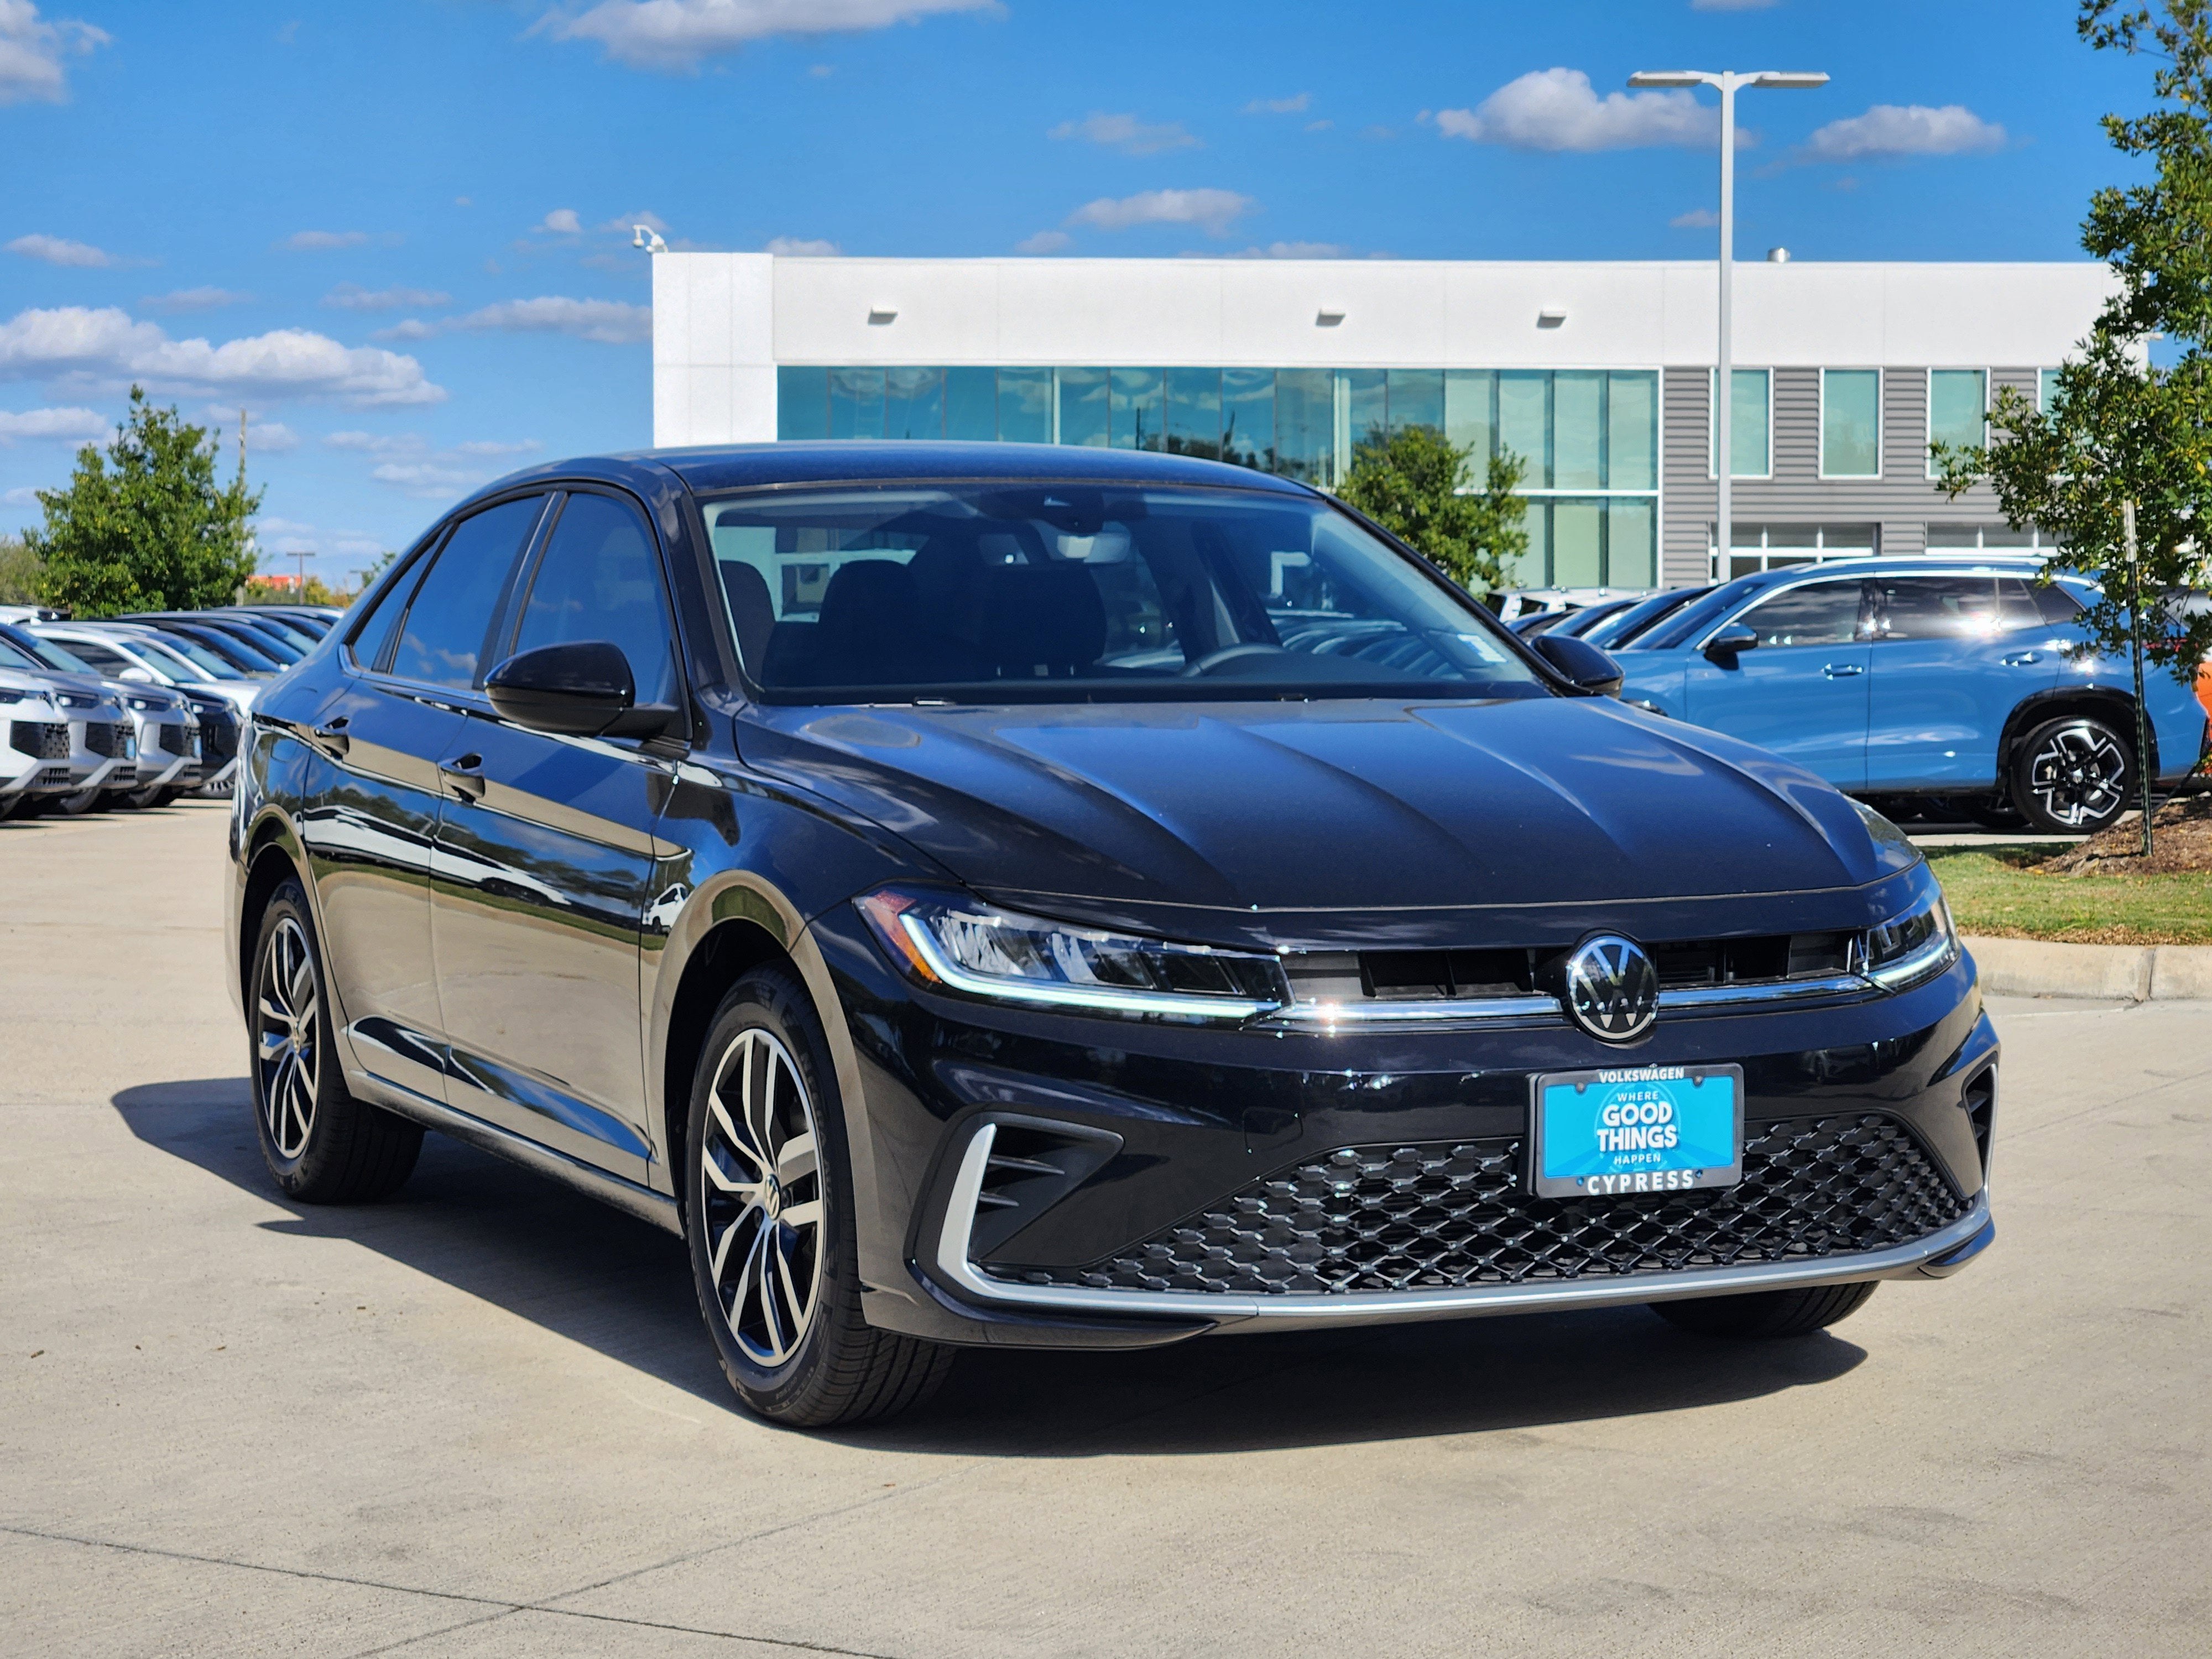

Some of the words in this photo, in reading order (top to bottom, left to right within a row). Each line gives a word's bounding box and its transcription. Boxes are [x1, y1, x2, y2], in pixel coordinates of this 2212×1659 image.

[1599, 1067, 1684, 1083] VOLKSWAGEN
[1617, 1091, 1658, 1102] WHERE
[1602, 1101, 1673, 1127] GOOD
[1597, 1124, 1678, 1152] THINGS
[1614, 1154, 1661, 1165] HAPPEN
[1587, 1170, 1694, 1194] CYPRESS
